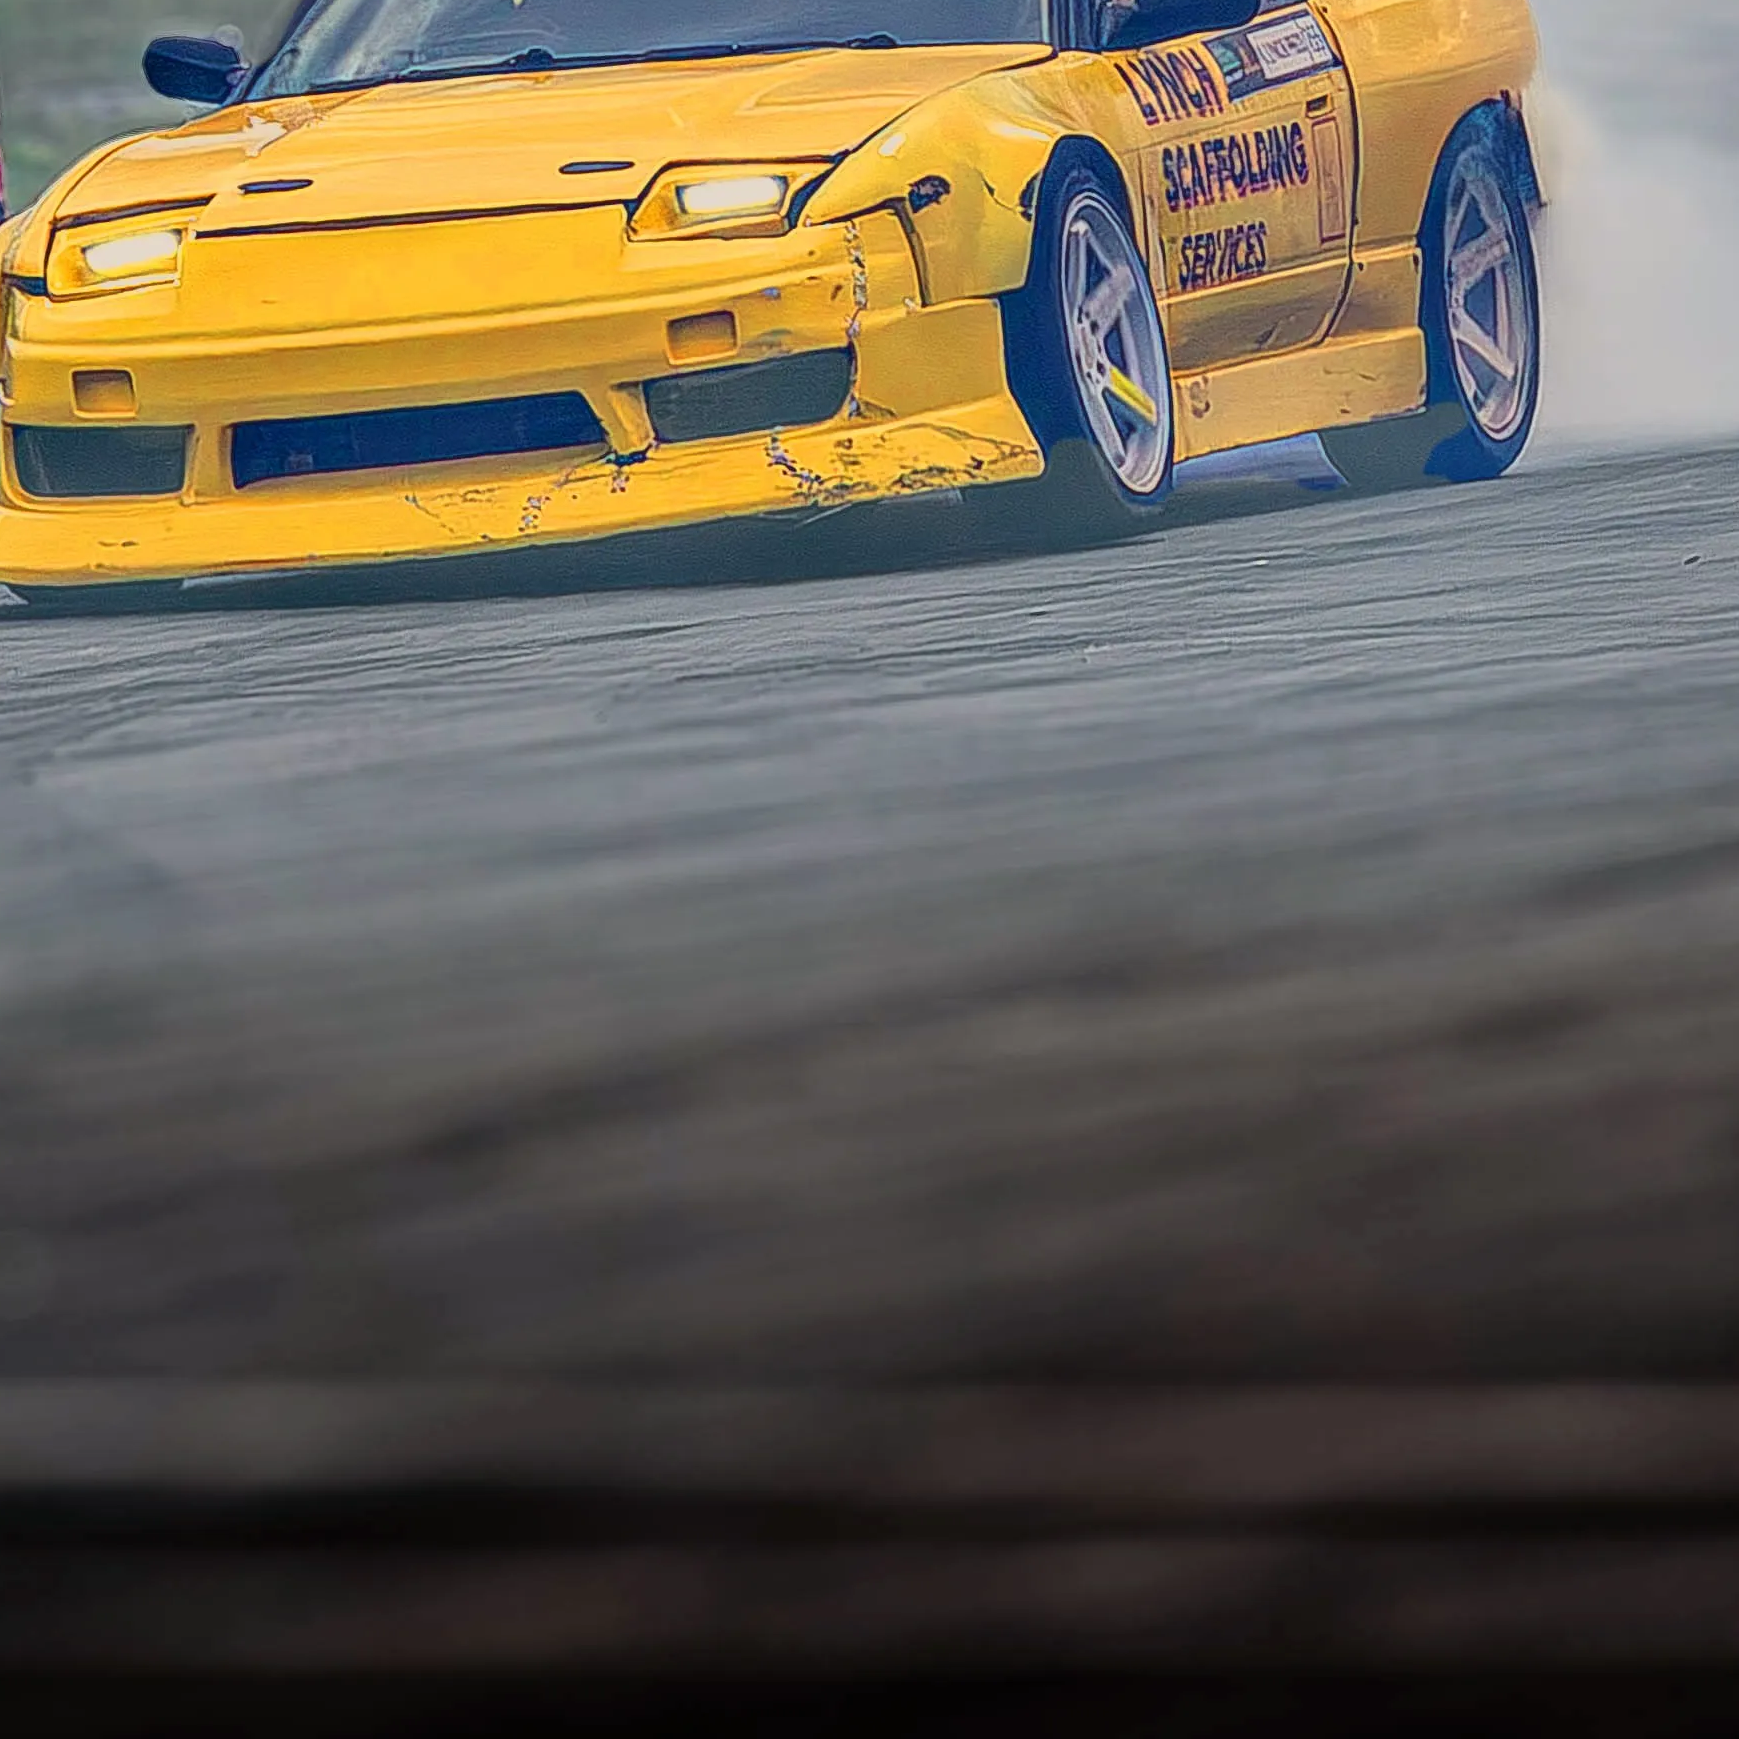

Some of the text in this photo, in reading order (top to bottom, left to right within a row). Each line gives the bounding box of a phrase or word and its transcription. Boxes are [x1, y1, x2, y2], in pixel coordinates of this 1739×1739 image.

[1113, 46, 1224, 126] LYNCH
[1161, 121, 1310, 212] SCAFFOLDING
[1178, 221, 1267, 292] SERVICES
